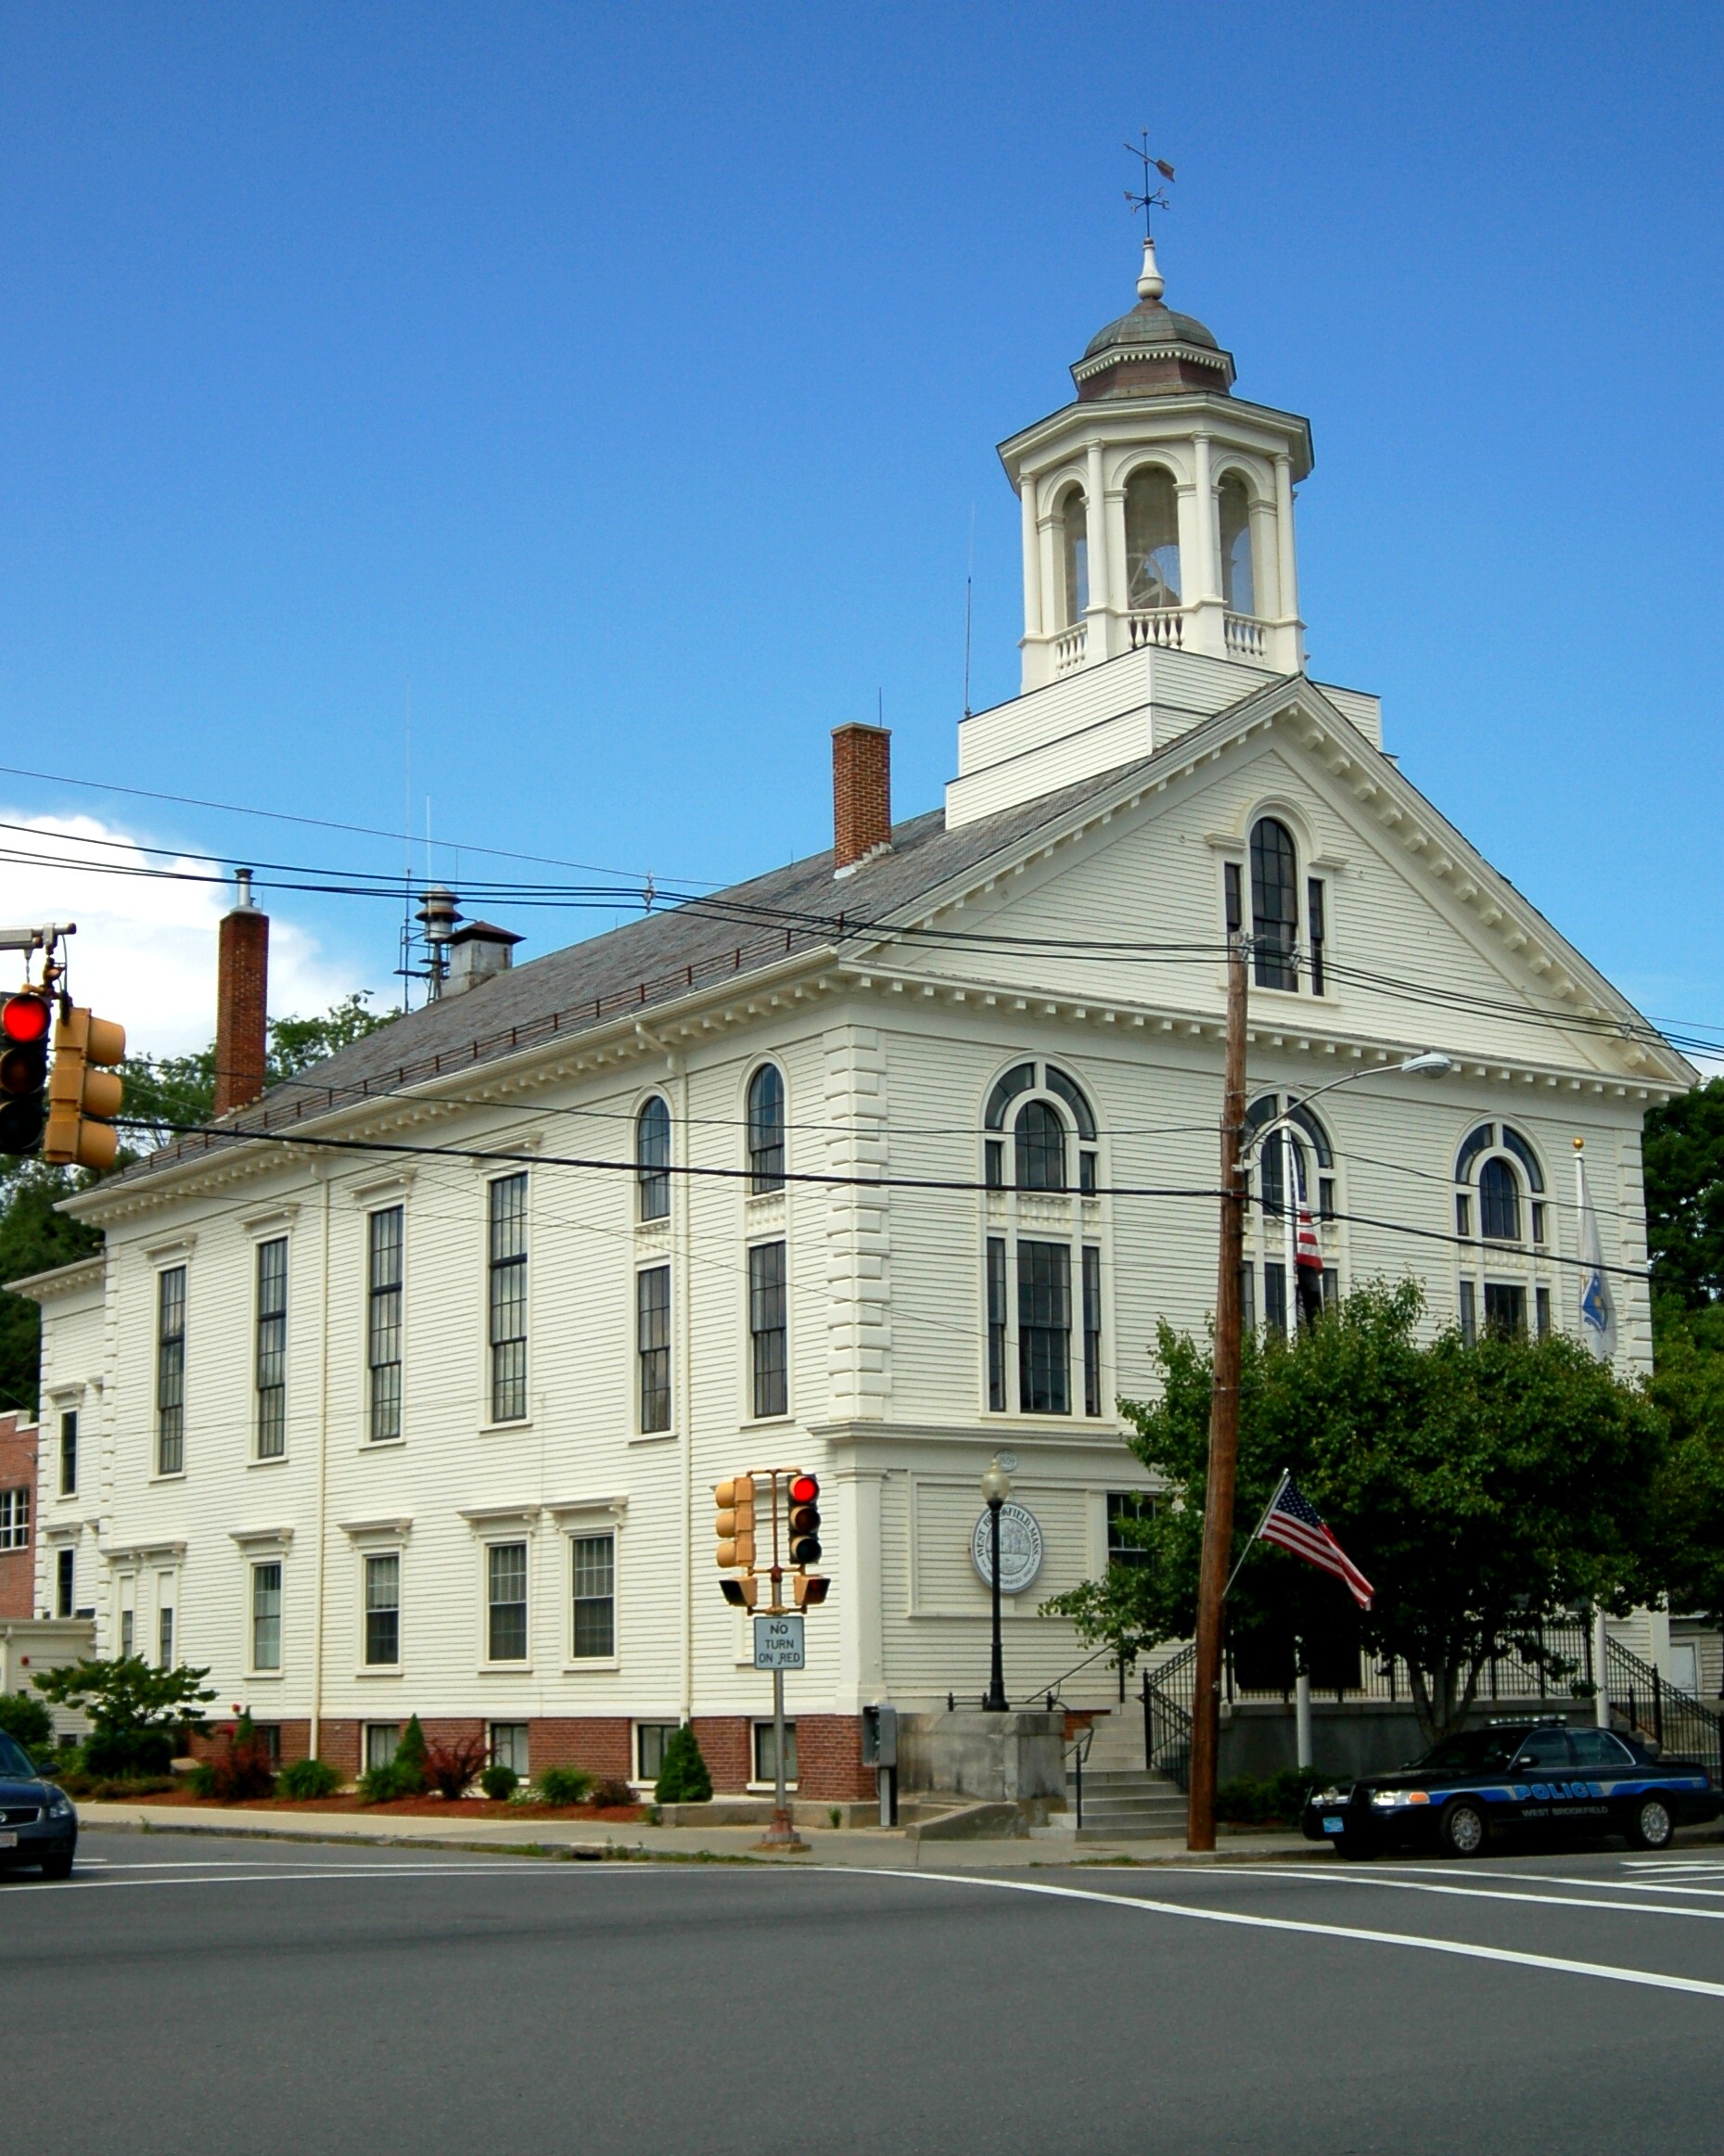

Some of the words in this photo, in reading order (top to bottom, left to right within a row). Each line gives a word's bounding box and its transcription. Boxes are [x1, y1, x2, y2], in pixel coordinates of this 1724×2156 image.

[977, 1528, 986, 1558] WEST
[770, 1624, 788, 1635] NO
[765, 1639, 794, 1650] TURN
[759, 1652, 773, 1664] ON
[780, 1652, 800, 1663] RED
[1513, 1781, 1604, 1800] POLICE
[1522, 1808, 1550, 1818] WEST
[1552, 1805, 1609, 1816] BROOKFIELD
